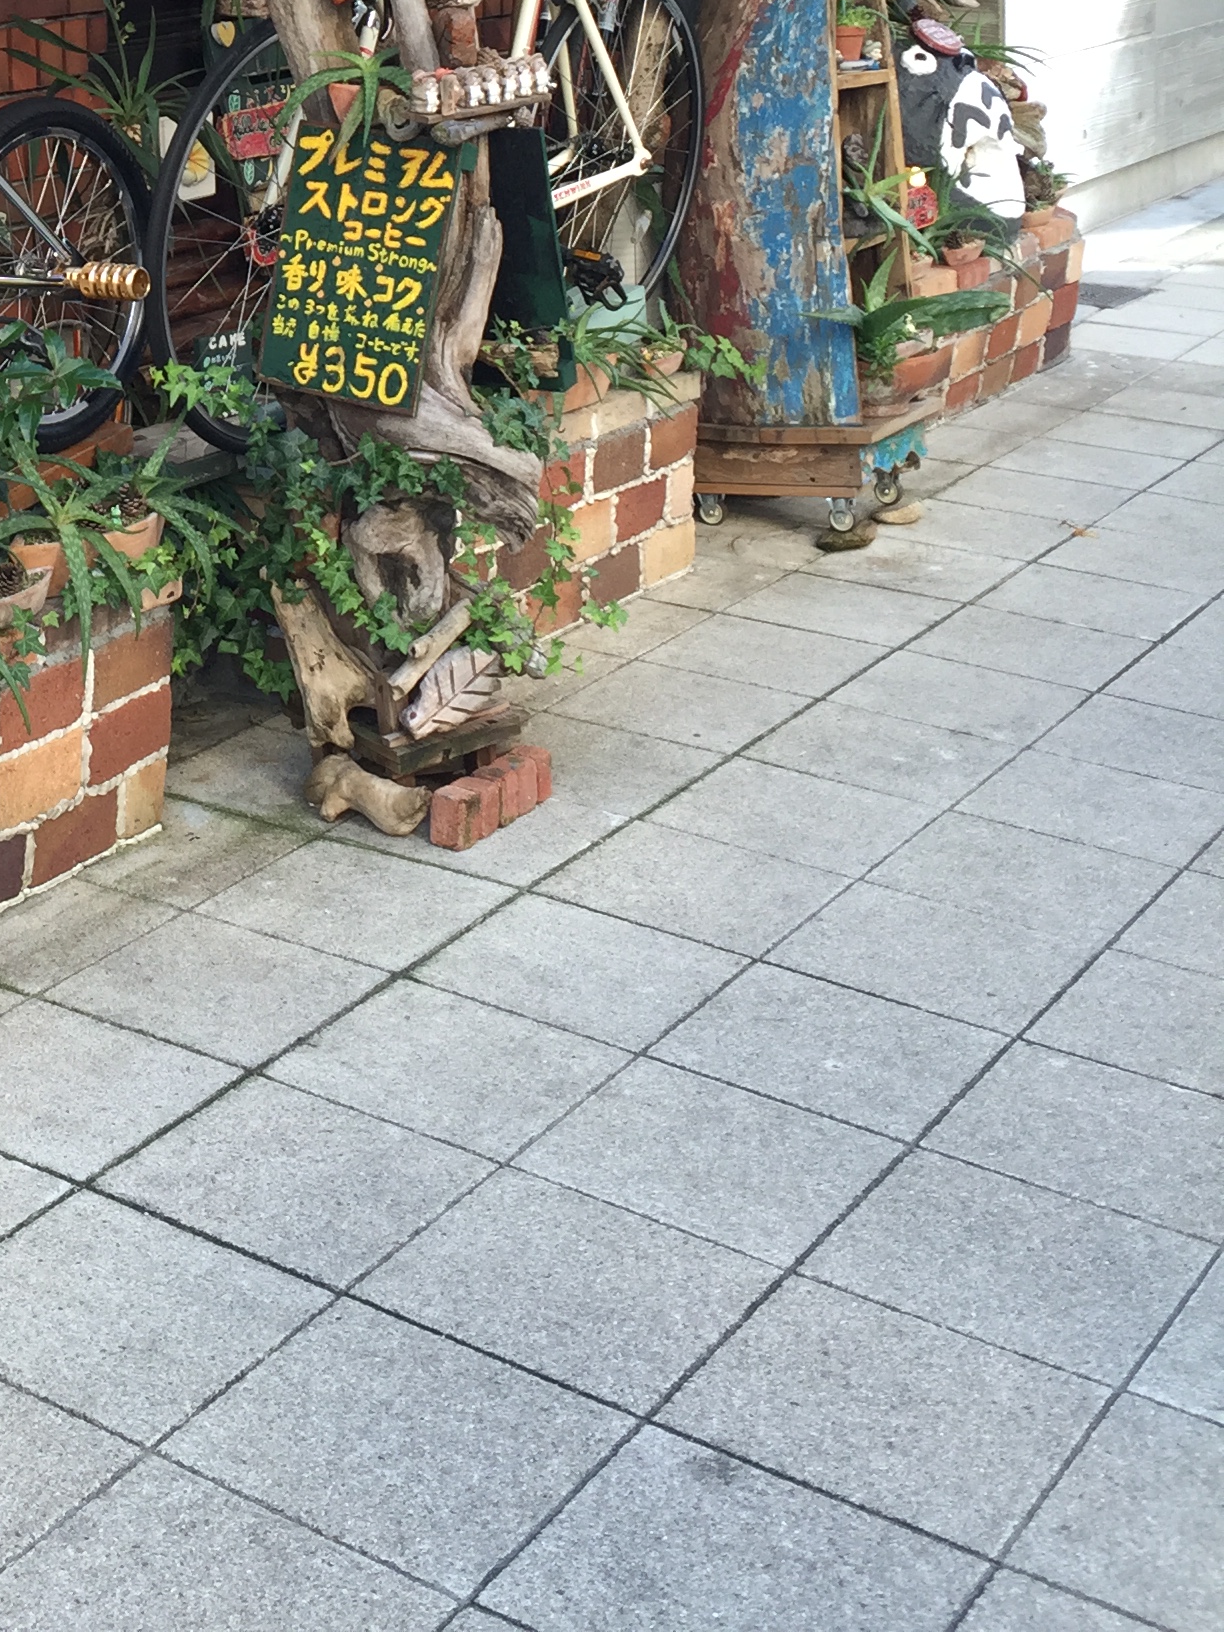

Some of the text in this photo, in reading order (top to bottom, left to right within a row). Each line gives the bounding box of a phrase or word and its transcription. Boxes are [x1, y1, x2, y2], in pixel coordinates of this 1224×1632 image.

[298, 129, 455, 191] プレミアム
[297, 180, 453, 230] ストロング
[342, 219, 427, 250] コーヒー
[281, 252, 423, 311] 香り 味 コク
[292, 342, 409, 406] ¥350
